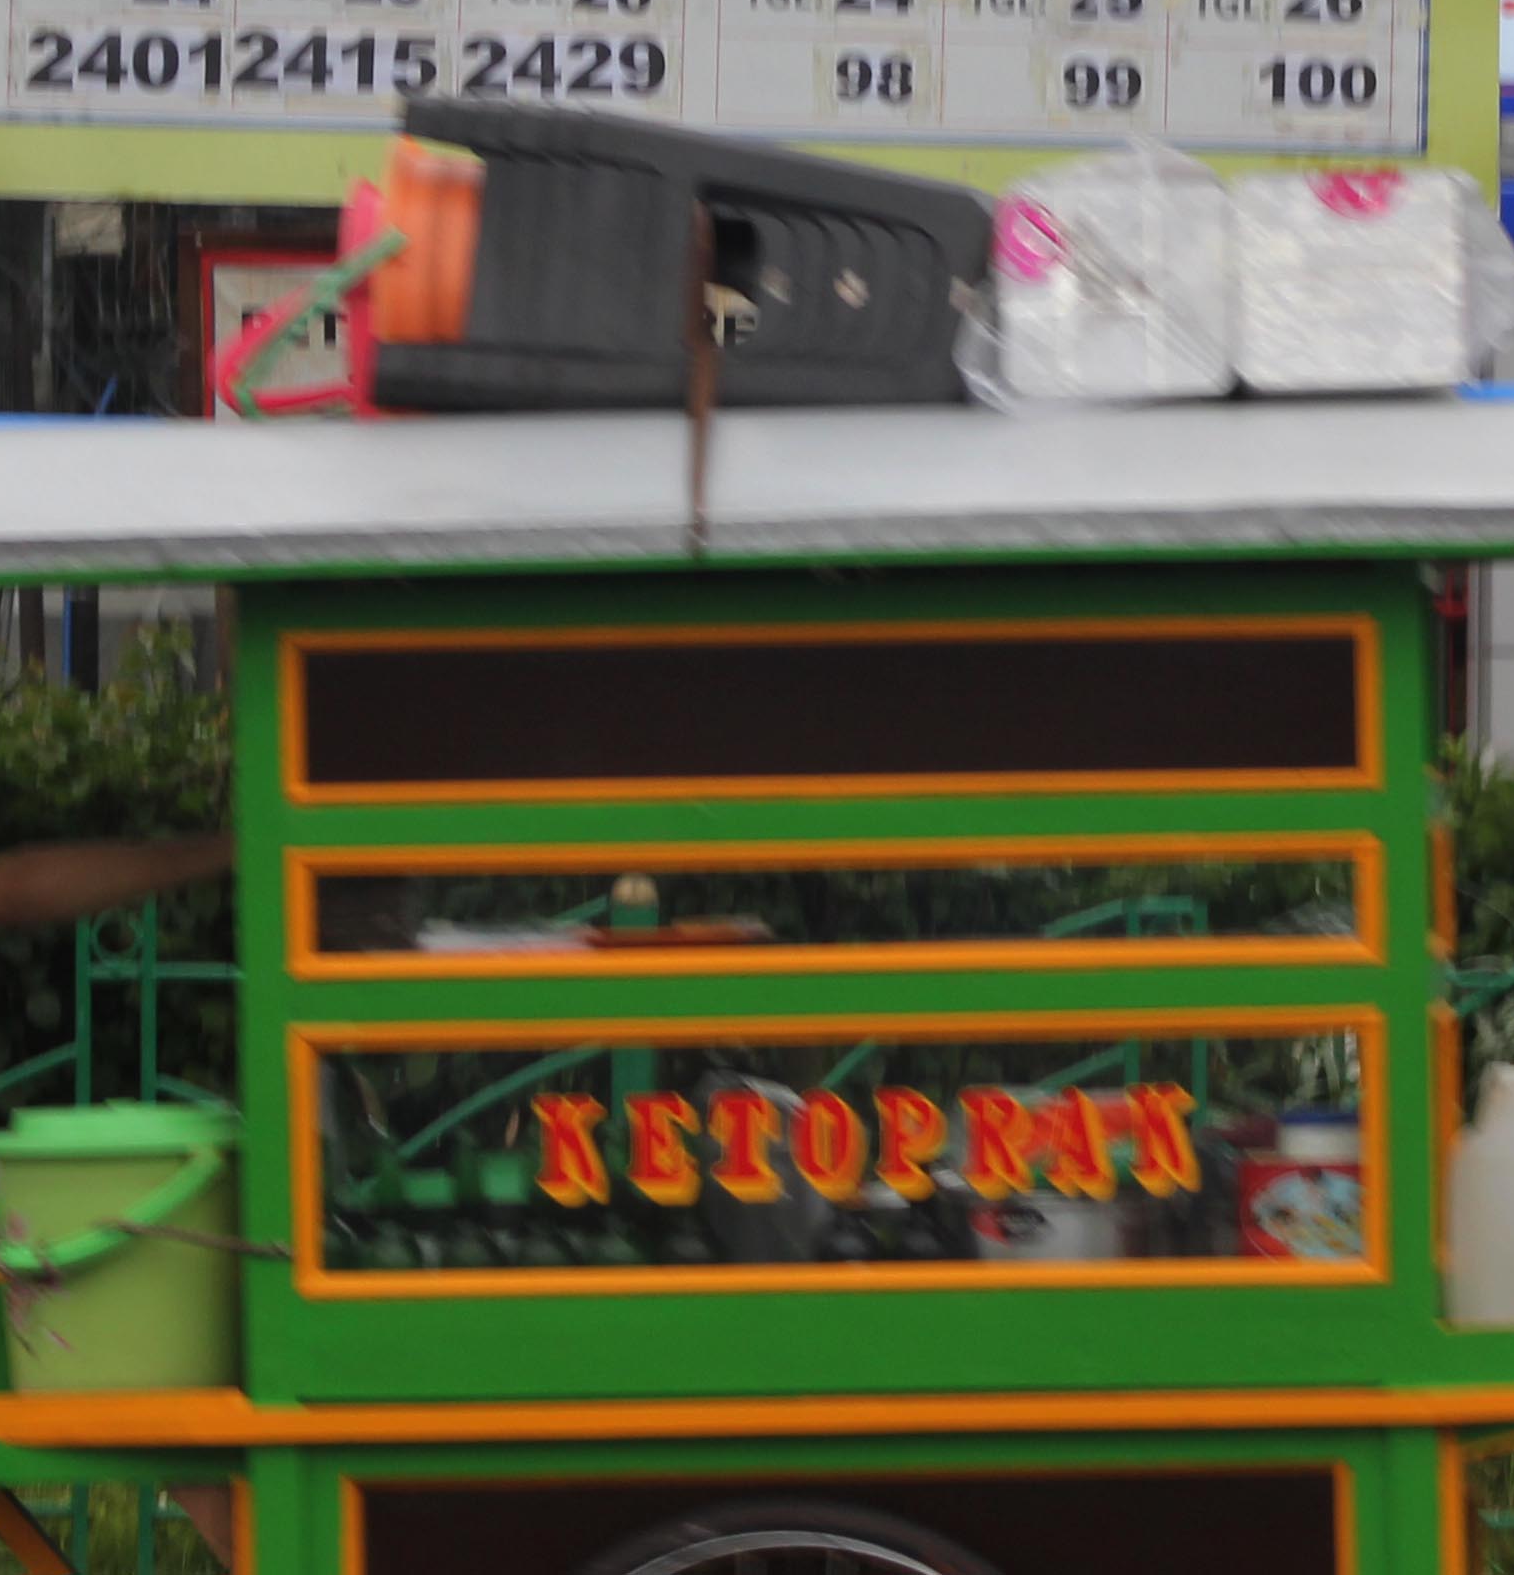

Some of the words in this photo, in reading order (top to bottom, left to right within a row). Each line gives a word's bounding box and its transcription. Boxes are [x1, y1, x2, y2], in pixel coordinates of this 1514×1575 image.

[26, 28, 223, 92] 2401
[234, 29, 437, 96] 2415
[460, 33, 666, 98] 2429
[835, 52, 913, 105] 98
[1063, 57, 1142, 109] 99
[1258, 57, 1377, 109] 100
